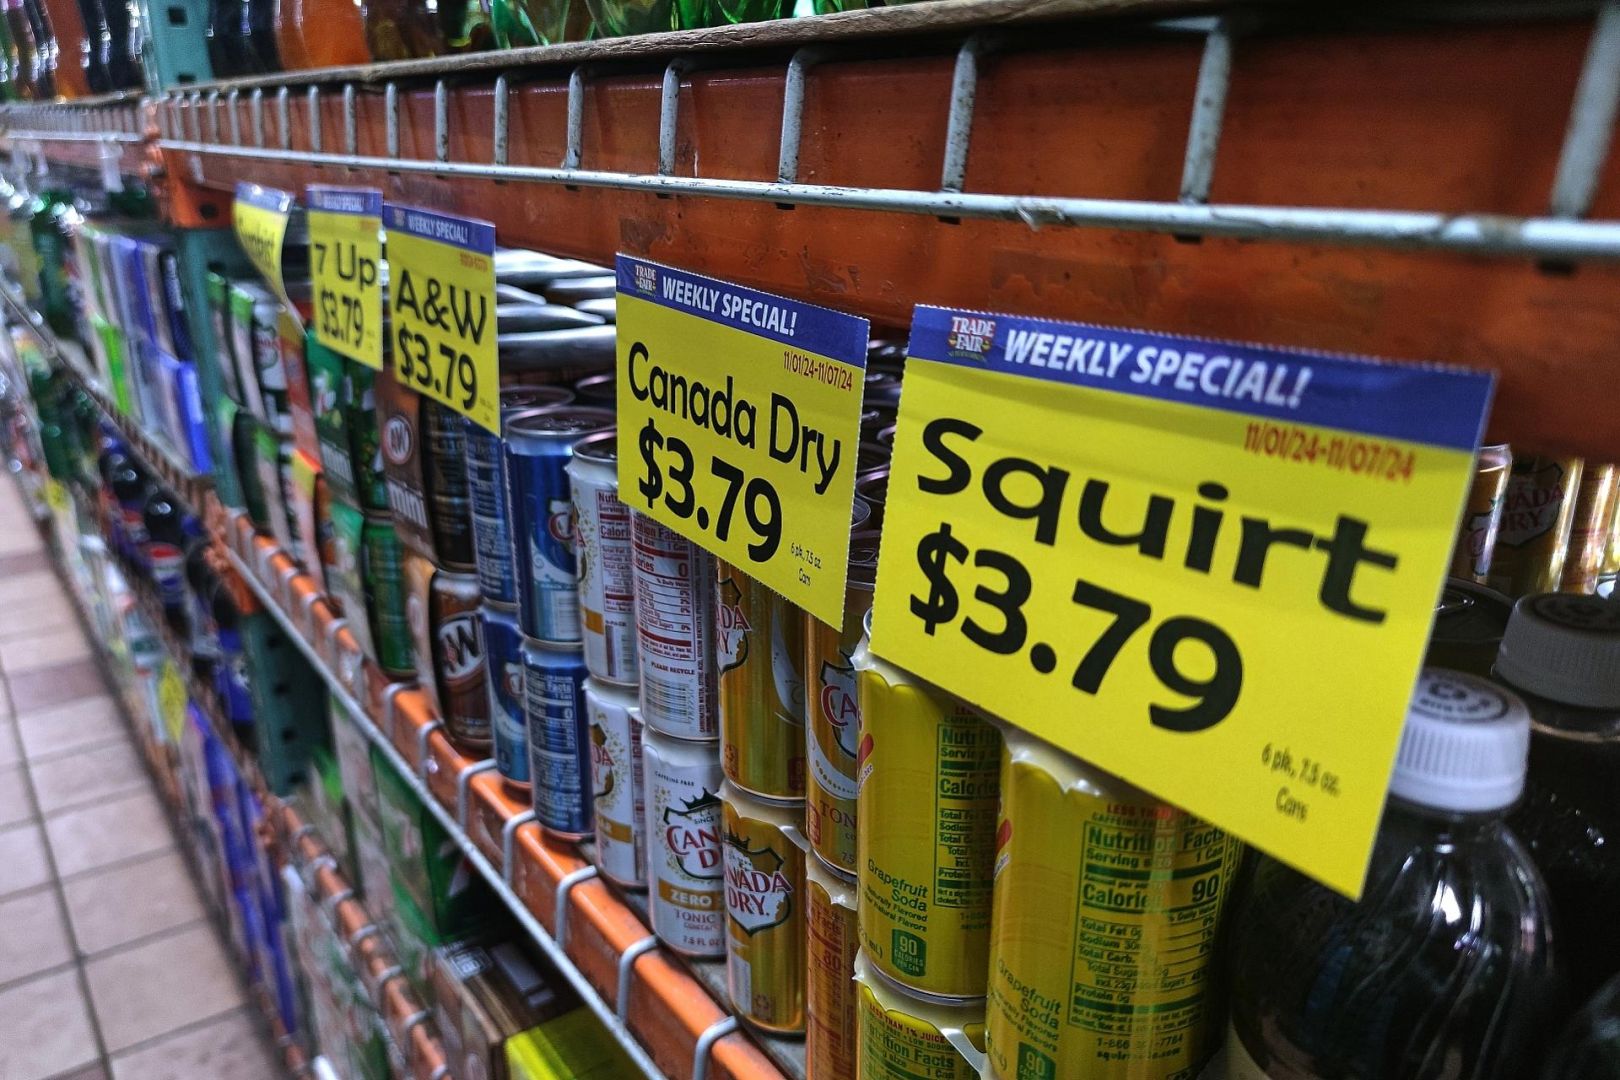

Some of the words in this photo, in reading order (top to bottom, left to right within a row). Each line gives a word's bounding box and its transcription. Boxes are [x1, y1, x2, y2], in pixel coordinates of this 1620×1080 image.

[315, 243, 327, 274] 7
[337, 242, 377, 291] Up
[635, 264, 656, 281] TRADE
[321, 286, 364, 349] $3.79
[396, 269, 487, 346] A&W
[662, 275, 720, 313] WEEKLY
[720, 293, 797, 337] SPECIAL!
[951, 316, 997, 339] TRADE
[955, 333, 984, 353] FAIR
[398, 322, 479, 411] $3.79
[783, 351, 853, 392] 11/01/24-11/07/24
[1004, 328, 1132, 380] WEEKLY
[1130, 344, 1313, 409] SPECIAL!
[628, 341, 756, 449] Canada
[768, 392, 841, 496] Dry
[1244, 420, 1416, 482] 11/01/24-11/07/24
[638, 418, 782, 563] $3.79
[600, 525, 631, 537] Calori
[916, 418, 1399, 626] Squirt
[909, 522, 1245, 734] $3.79
[1261, 742, 1272, 766] 6
[820, 800, 857, 829] TON
[1275, 785, 1308, 823] Cans
[666, 825, 721, 855] CAN
[1183, 826, 1226, 850] Facts
[1086, 847, 1139, 868] Serving
[723, 869, 793, 893] NADA
[868, 858, 928, 899] Grapefruit
[1082, 883, 1148, 908] Calori
[1191, 873, 1220, 904] 90
[670, 890, 712, 907] ZERO
[891, 888, 928, 912] Soda
[674, 908, 716, 924] TONIC
[1110, 924, 1127, 936] Fat
[899, 935, 917, 956] 90
[1113, 965, 1138, 978] Suga
[1020, 998, 1059, 1030] Soda
[885, 1015, 904, 1031] THAN
[906, 1026, 918, 1038] 1%
[920, 1031, 946, 1045] JUICE
[914, 1047, 955, 1070] Facts
[1026, 1051, 1046, 1076] 90
